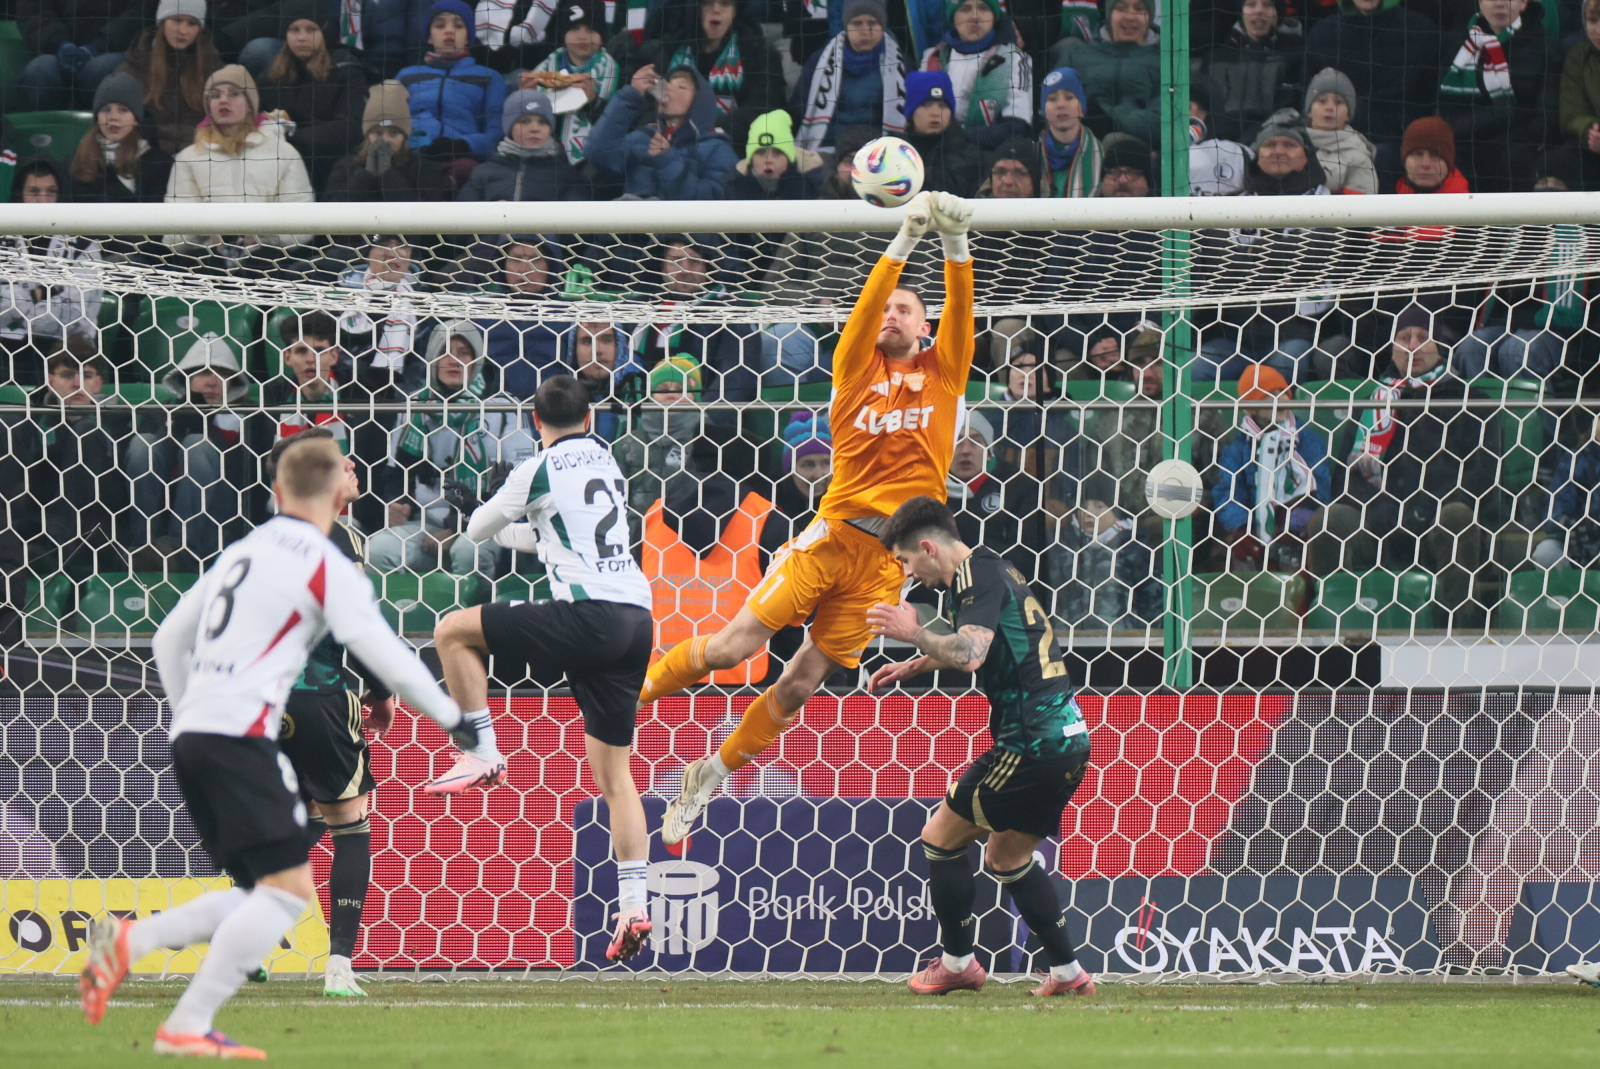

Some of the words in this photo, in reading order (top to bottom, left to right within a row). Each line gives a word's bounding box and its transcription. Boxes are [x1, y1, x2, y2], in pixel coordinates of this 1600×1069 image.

[853, 405, 935, 435] LVBET
[206, 557, 251, 640] 8
[651, 574, 733, 593] STEWARD
[337, 898, 362, 909] 1945
[749, 885, 838, 921] Bank
[1114, 926, 1403, 973] OYAKATA
